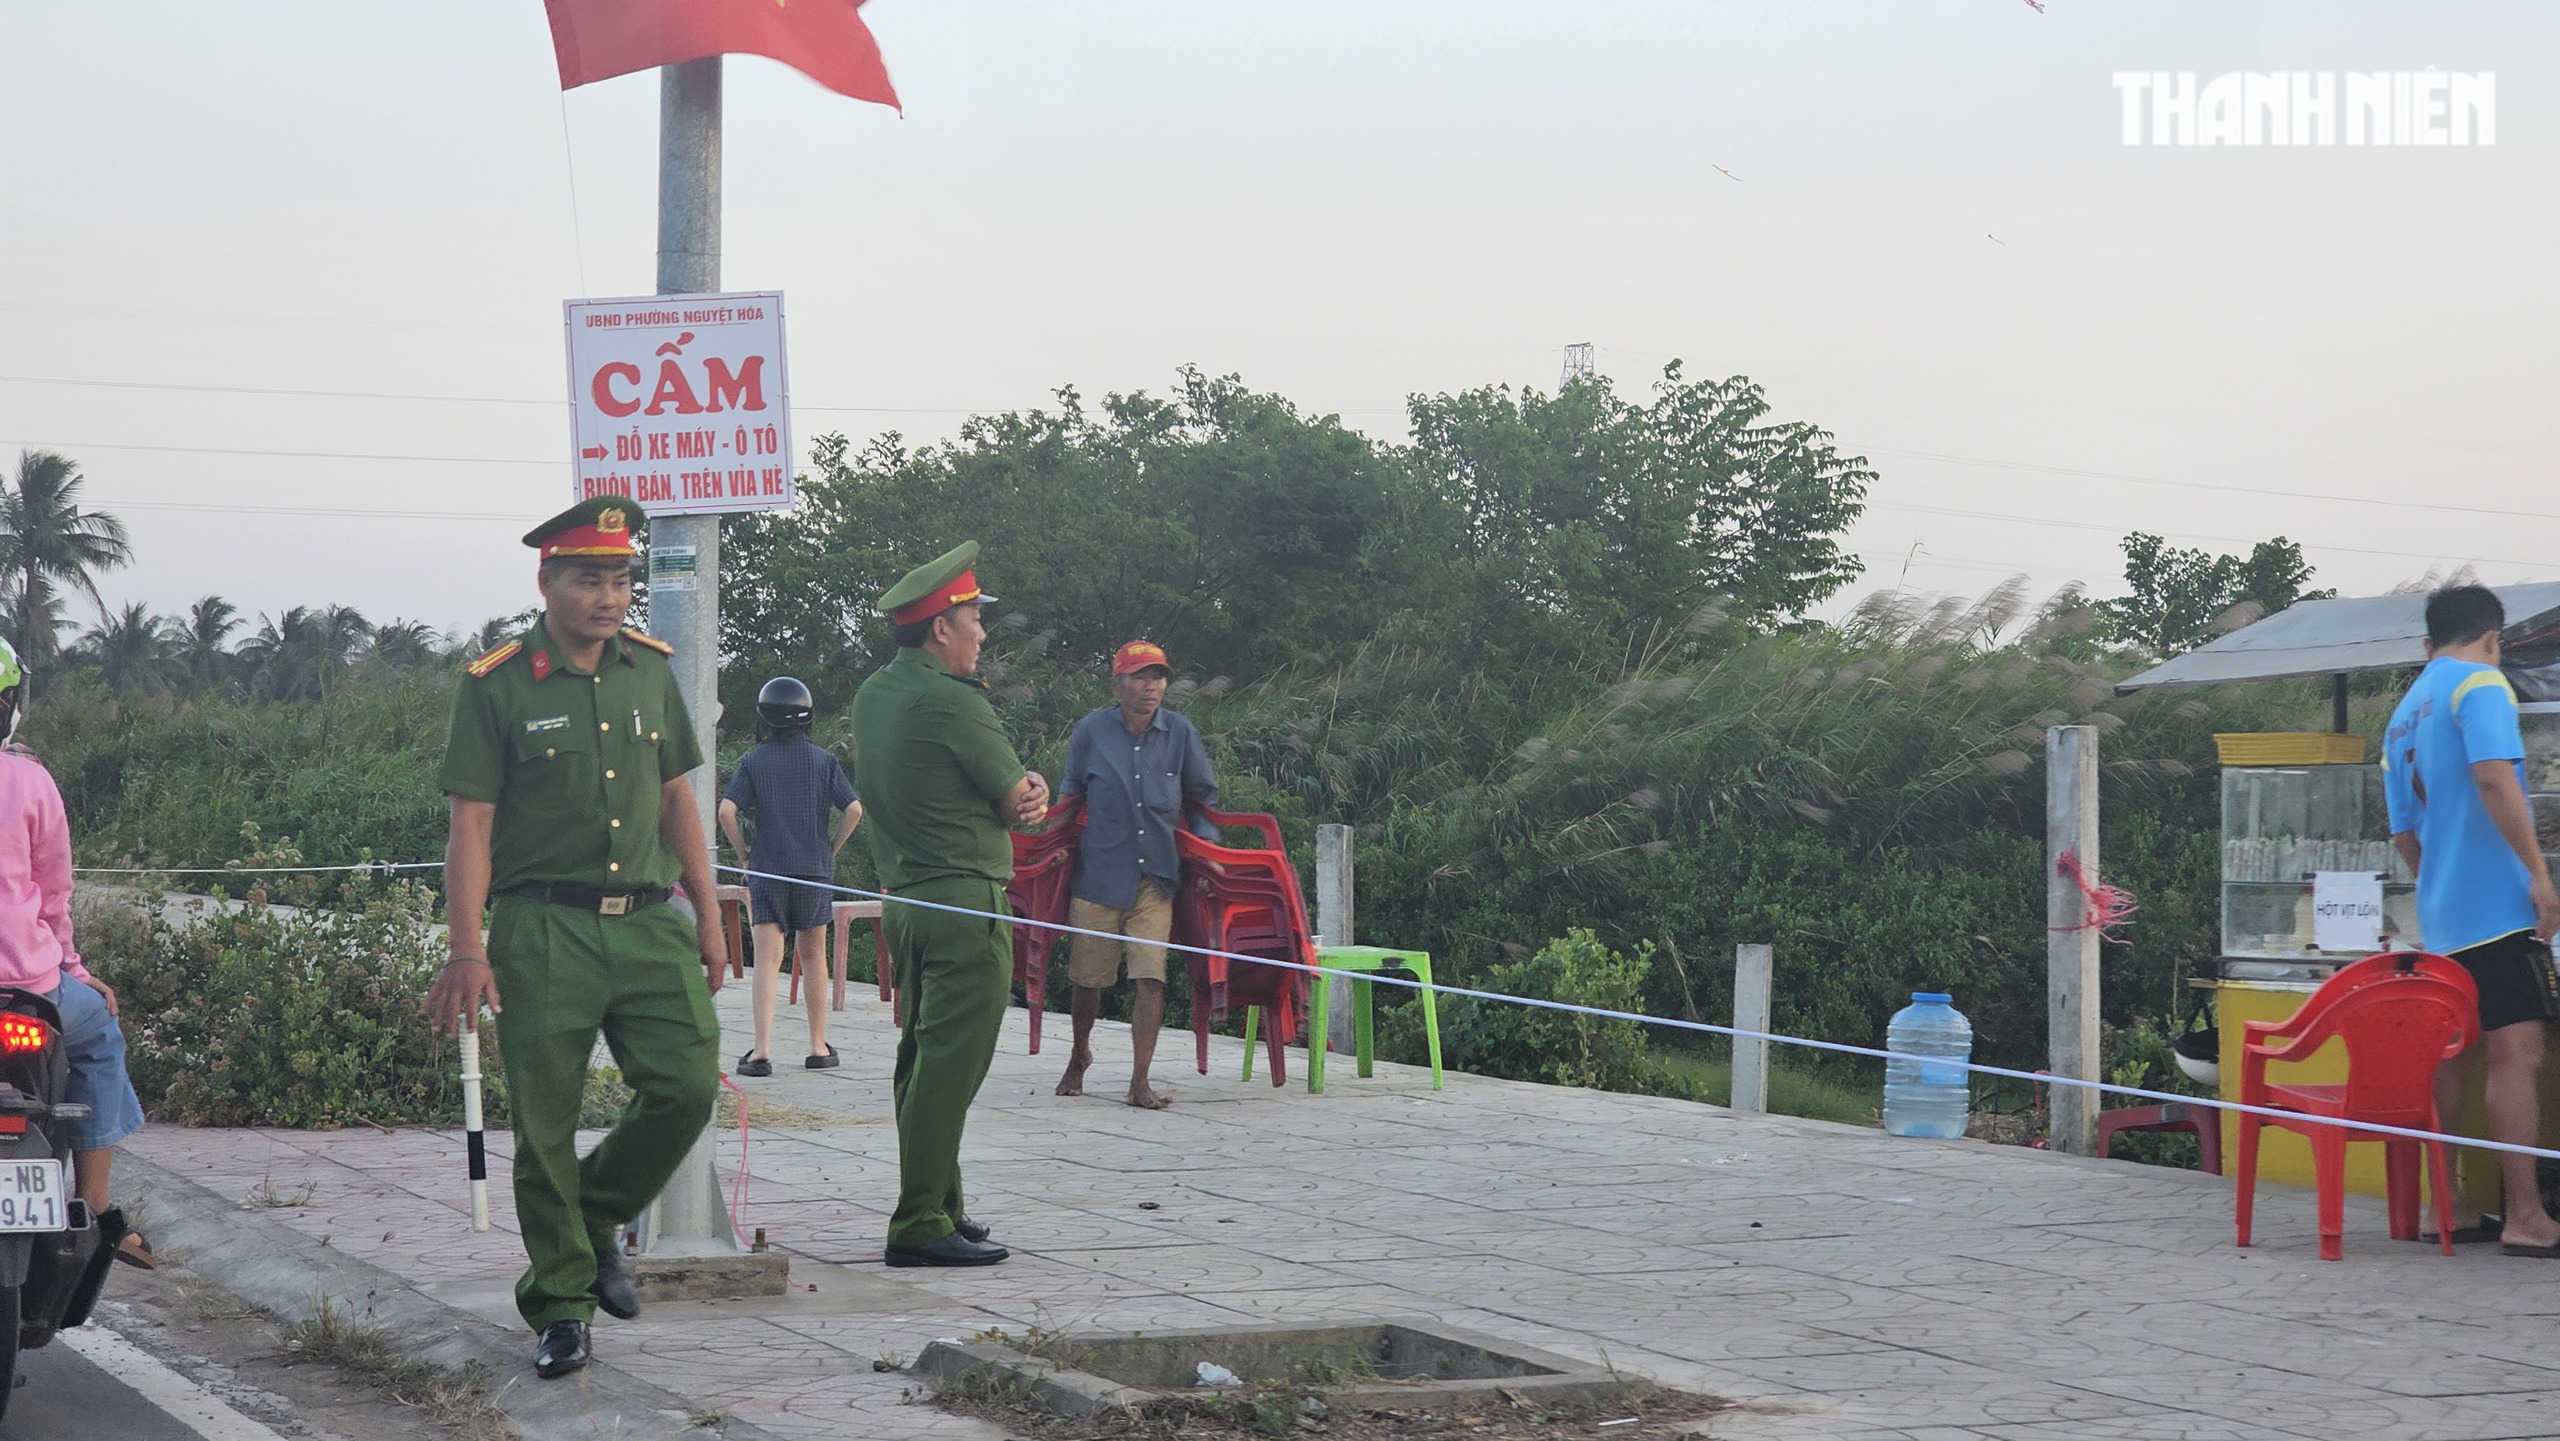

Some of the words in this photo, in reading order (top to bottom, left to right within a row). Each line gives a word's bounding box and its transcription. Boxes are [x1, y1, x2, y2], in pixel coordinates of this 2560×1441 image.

[586, 314, 621, 327] UBND
[626, 309, 679, 326] PHƯỜNG
[684, 306, 733, 325] NGUYỆT
[592, 332, 767, 418] CẤM
[616, 425, 642, 461] ĐỖ
[648, 432, 670, 460] XE
[676, 426, 716, 459] MÁY
[735, 424, 748, 456] Ô
[753, 422, 777, 454] TÔ
[584, 471, 631, 501] BUÔN
[637, 469, 676, 503] BÁN,
[680, 467, 723, 499] TRÊN
[728, 463, 758, 497] VỈA
[762, 463, 784, 496] HÈ
[2316, 900, 2339, 919] HỘT
[2341, 903, 2356, 919] VỊT
[2358, 900, 2379, 919] LỘN
[2, 1197, 55, 1226] 9.41
